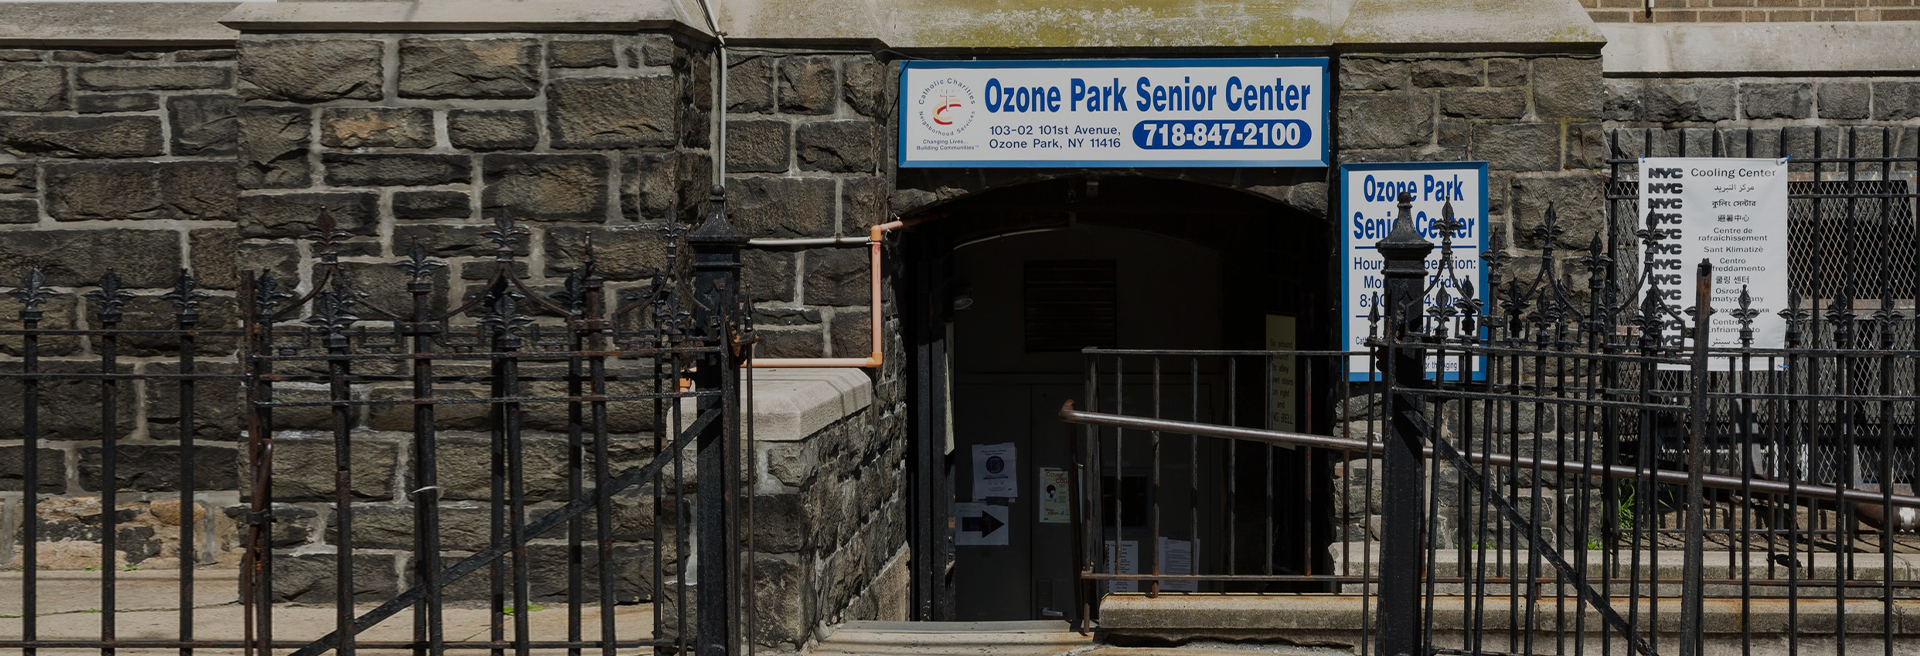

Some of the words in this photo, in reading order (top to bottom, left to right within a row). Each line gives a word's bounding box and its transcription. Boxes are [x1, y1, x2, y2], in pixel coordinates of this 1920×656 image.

[918, 79, 945, 105] Catholic
[946, 77, 976, 105] Charities
[985, 77, 1061, 113] Ozone
[1071, 77, 1128, 112] Park
[1136, 76, 1217, 112] Senior
[1226, 76, 1311, 112] Center
[918, 111, 955, 137] Neighborhood
[956, 111, 976, 134] Services
[989, 125, 1033, 135] 103-02
[1038, 125, 1069, 135] 101st
[1074, 125, 1121, 136] Avenue,
[1143, 123, 1301, 146] 718-847-2100
[989, 138, 1027, 148] Ozone
[1033, 138, 1062, 149] Park,
[1067, 138, 1084, 148] NY
[1090, 138, 1121, 148] 11416
[1648, 167, 1683, 179] NYC
[1691, 168, 1735, 179] Cooling
[1738, 168, 1776, 177] Center
[1424, 174, 1464, 201] Park
[1648, 183, 1683, 194] NYC
[1648, 198, 1683, 209] NYC
[1734, 275, 1750, 284] 센터
